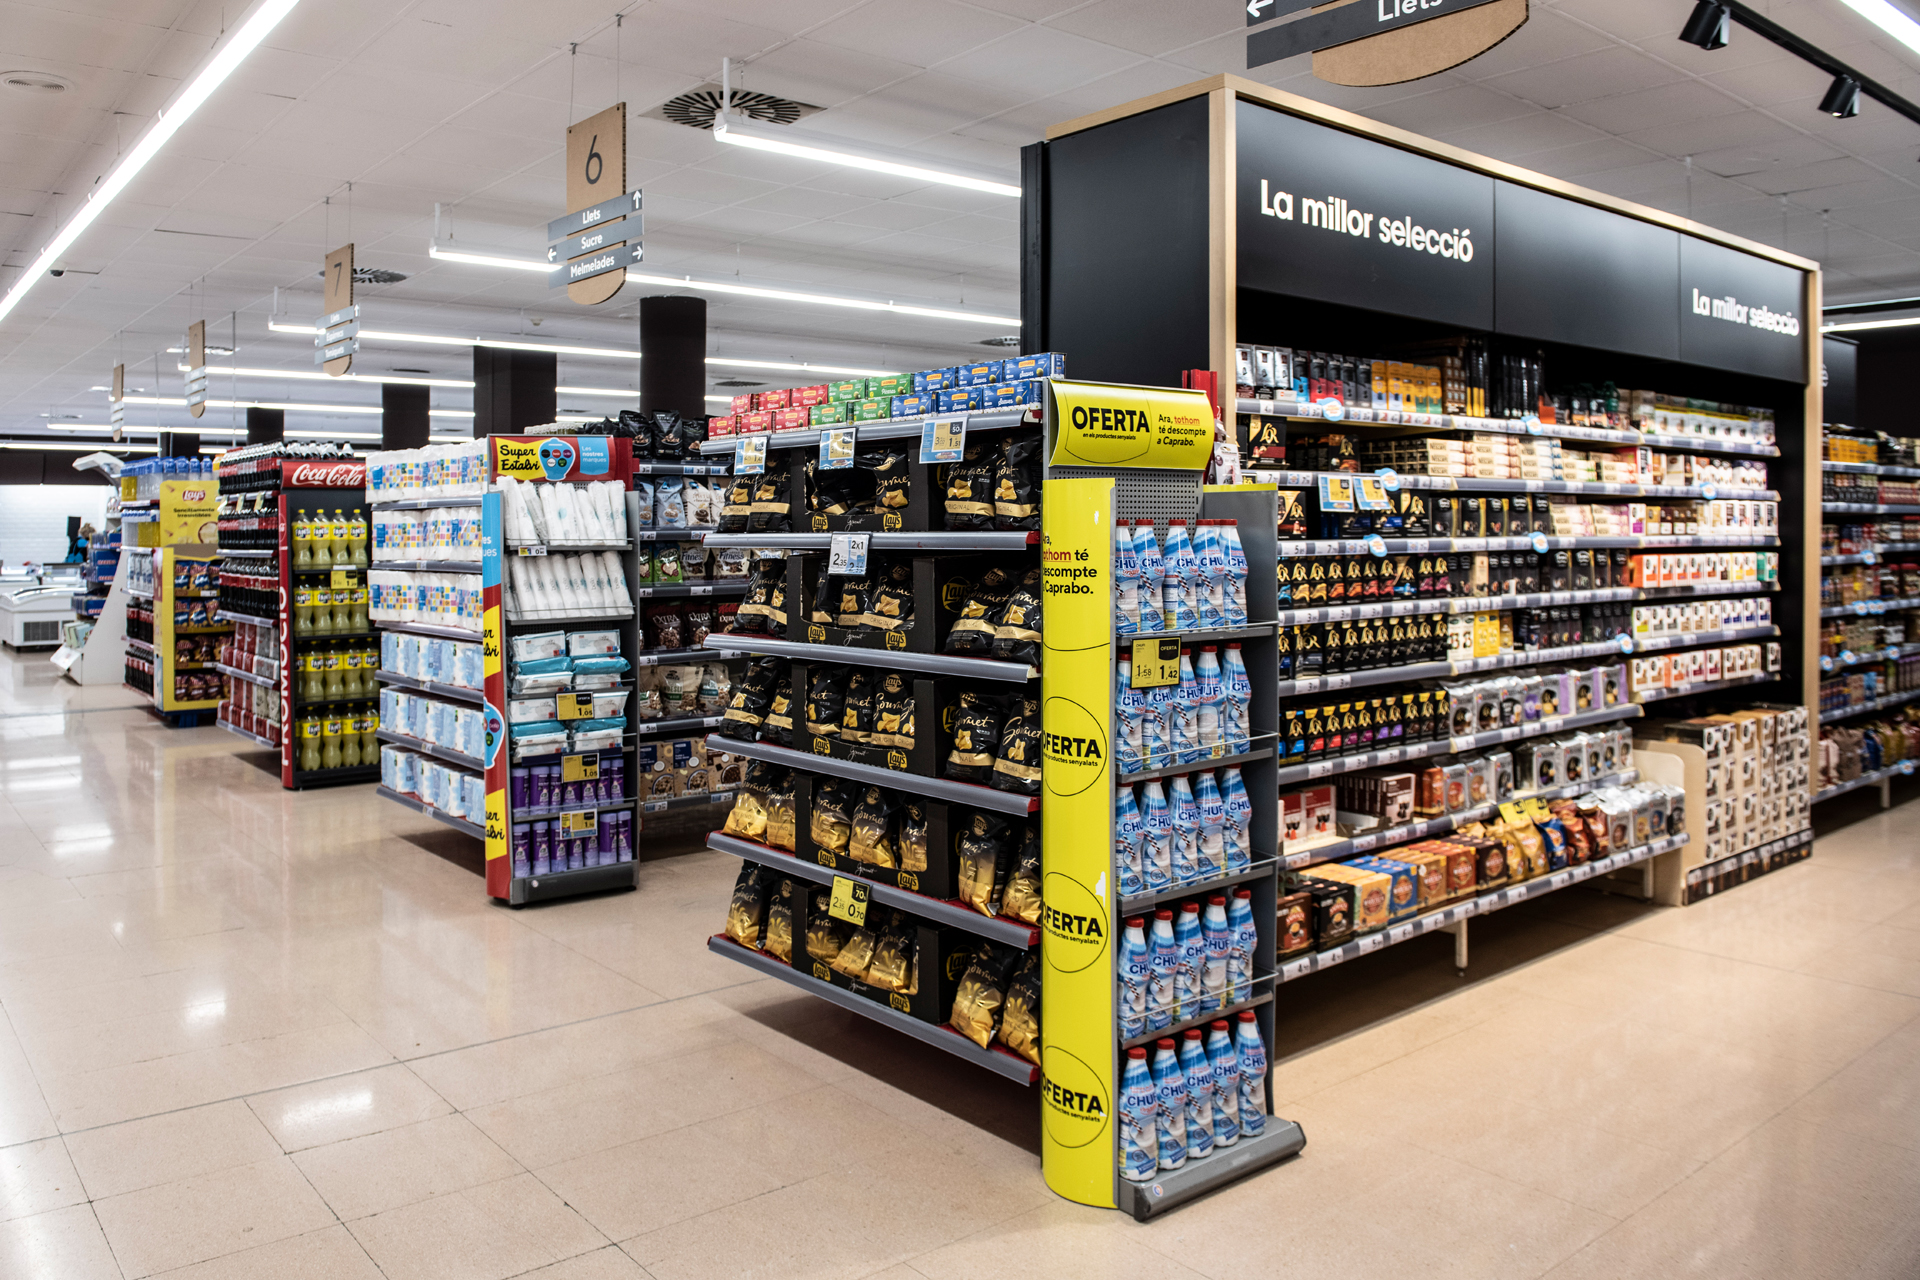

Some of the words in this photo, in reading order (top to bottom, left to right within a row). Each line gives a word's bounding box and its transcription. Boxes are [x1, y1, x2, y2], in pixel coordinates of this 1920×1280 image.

[585, 134, 603, 185] 6
[582, 209, 601, 224] Llets
[1261, 179, 1294, 220] La
[1302, 196, 1374, 238] millor
[1379, 216, 1474, 262] selecció
[581, 234, 602, 250] Sucre
[570, 255, 615, 278] Melmelades
[334, 262, 342, 297] 7
[1692, 288, 1710, 316] La
[1712, 296, 1748, 324] millor
[1072, 406, 1150, 432] OFERTA
[1158, 414, 1173, 424] Ara,
[1174, 415, 1200, 424] tothom
[1167, 426, 1206, 437] descompte
[1163, 436, 1195, 447] Caprabo.
[500, 444, 536, 459] Super
[501, 458, 540, 471] Estalvi
[292, 464, 365, 486] Coca-Cola
[851, 541, 864, 550] 2x1
[719, 551, 744, 561] Fitness
[833, 552, 847, 567] 2,35
[1074, 549, 1089, 561] té
[1045, 580, 1094, 596] Caprabo.
[1136, 664, 1152, 677] 1,58
[1160, 665, 1178, 680] 1,42
[578, 707, 593, 717] 1,05
[583, 768, 598, 778] 1,05
[848, 904, 864, 920] 0,70
[1070, 936, 1099, 945] senyalats
[1070, 1112, 1100, 1122] senyalats
